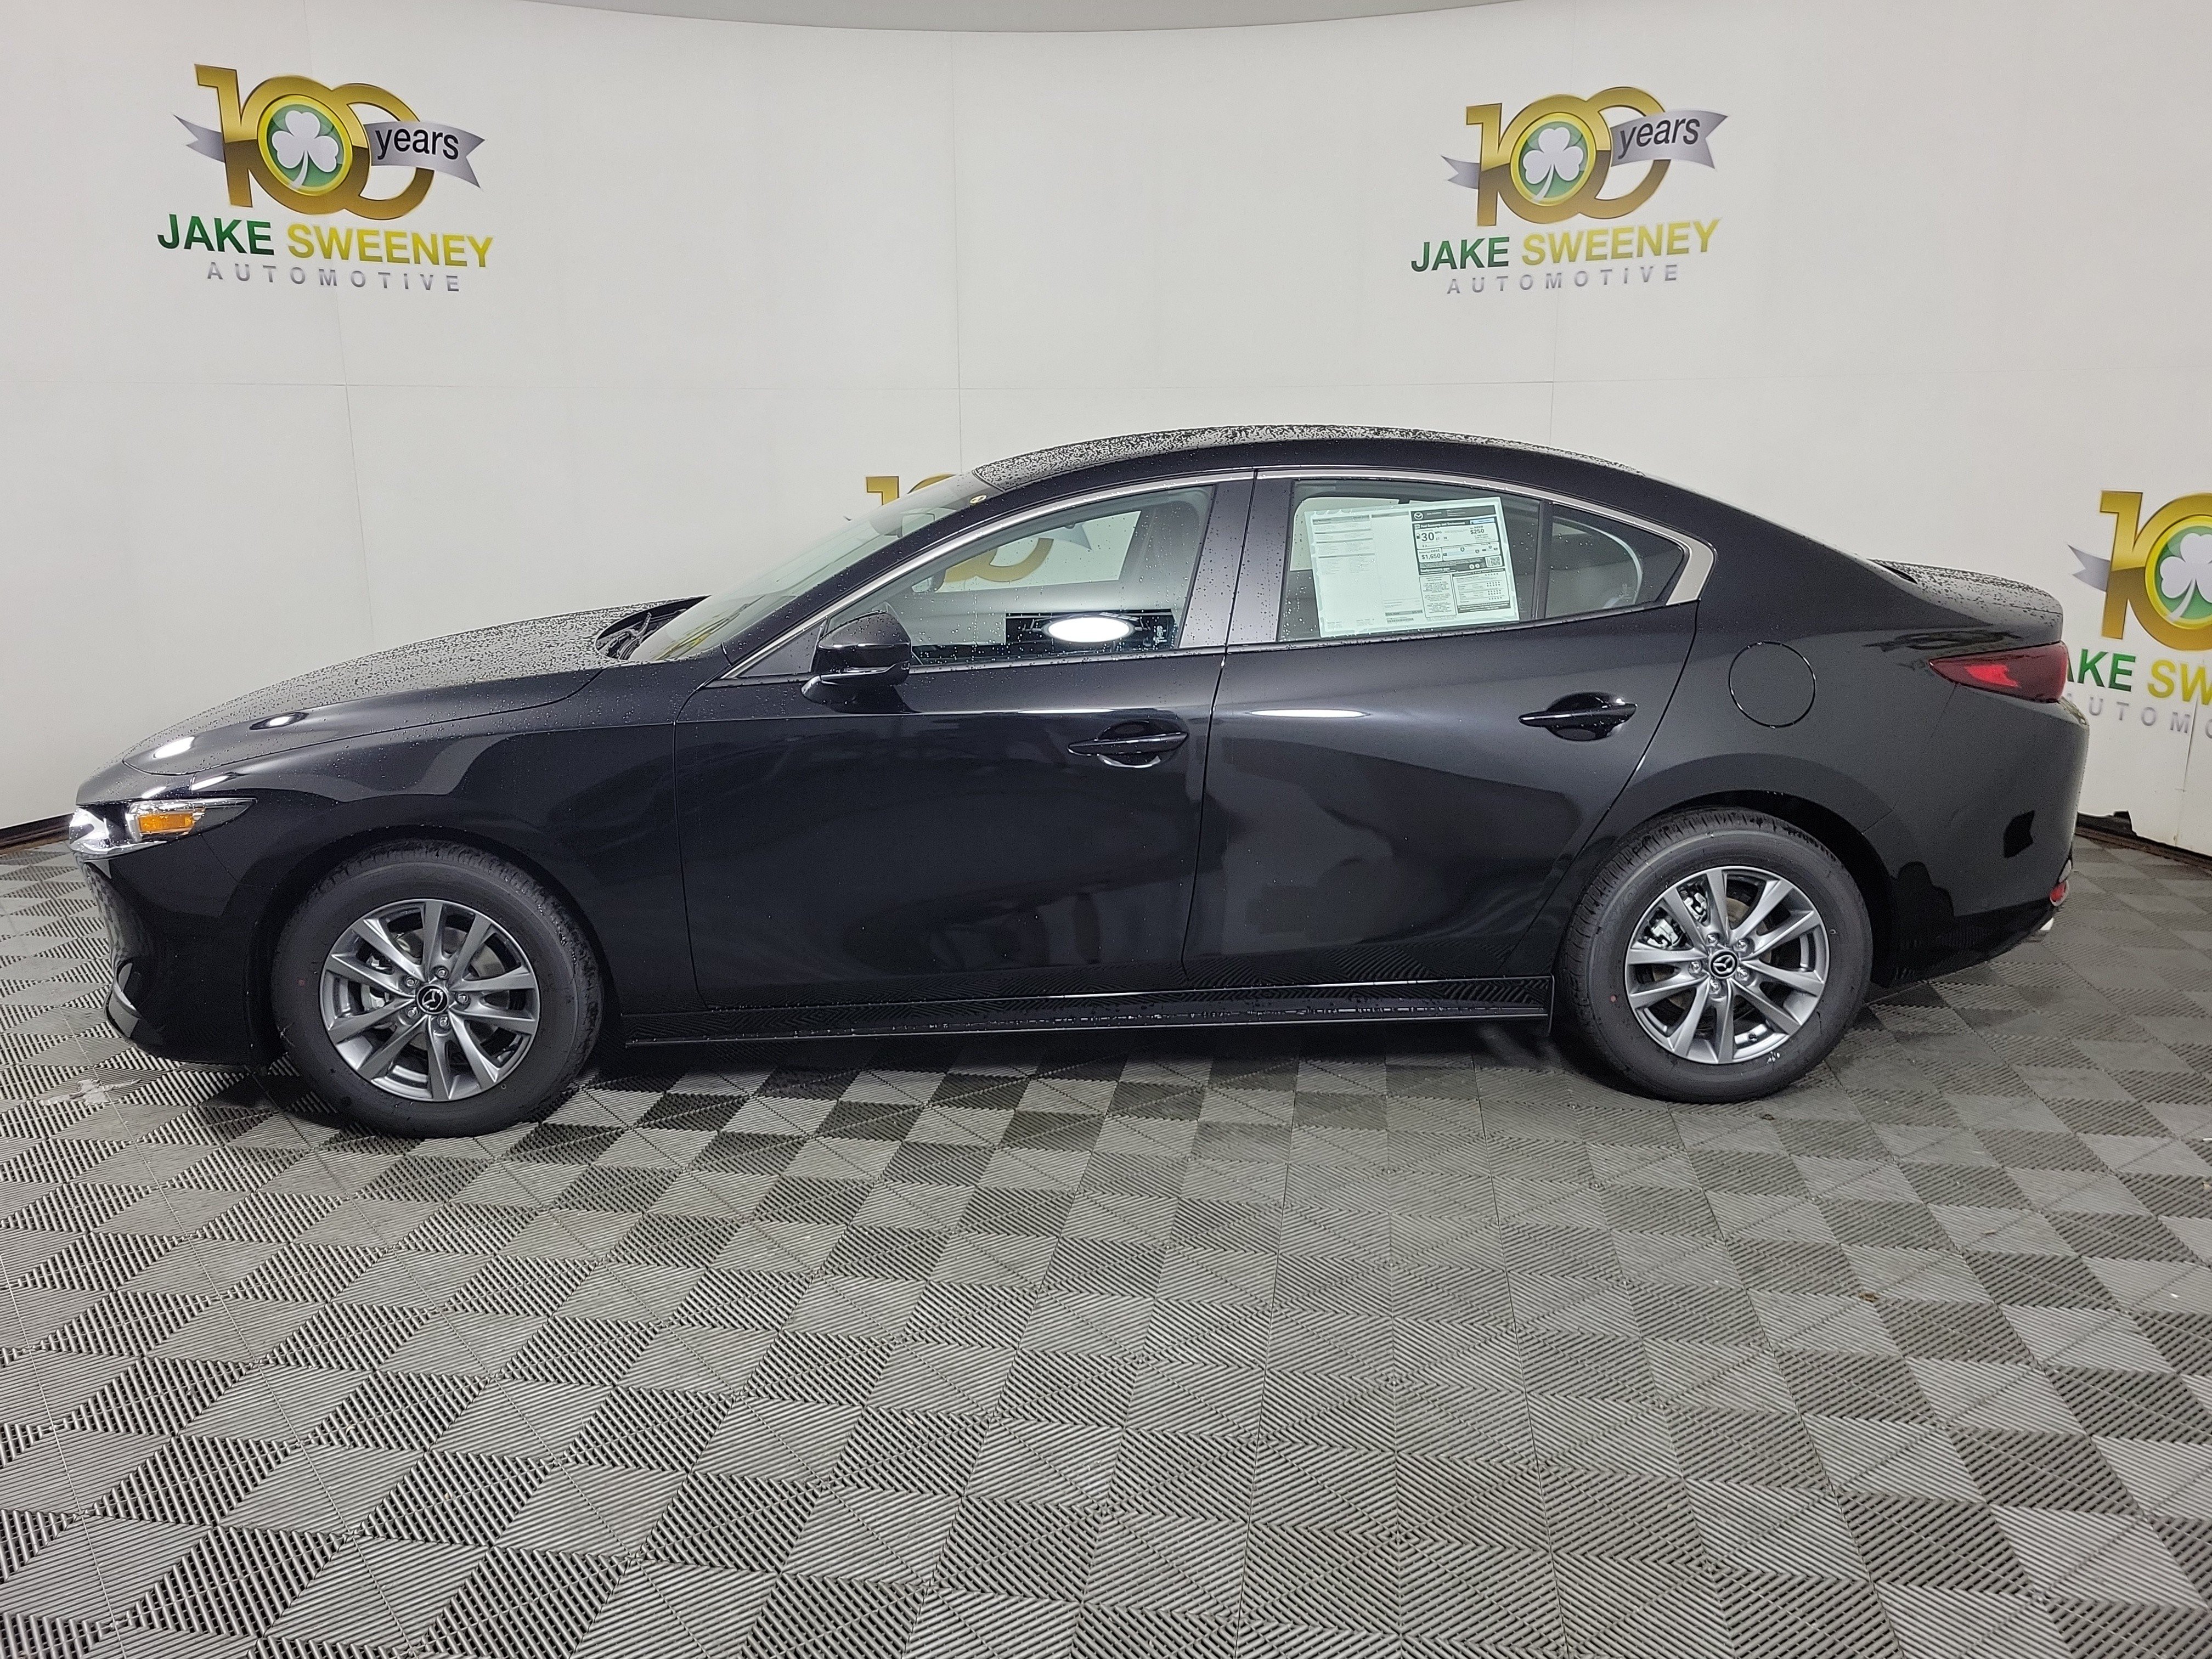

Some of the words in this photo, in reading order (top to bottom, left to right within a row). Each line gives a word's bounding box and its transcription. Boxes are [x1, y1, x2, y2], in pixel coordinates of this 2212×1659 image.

[194, 63, 435, 221] 100
[375, 127, 459, 161] years
[1465, 86, 1671, 227] 100
[1618, 116, 1701, 159] years
[157, 213, 275, 256] JAKE
[286, 223, 494, 268] SWEENEY
[1411, 236, 1510, 272] JAKE
[1521, 218, 1722, 267] SWEENEY
[207, 261, 460, 292] AUTOMOTIVE
[1447, 264, 1678, 295] AUTOMOTIVE
[1421, 532, 1435, 541] 30
[2100, 490, 2212, 651] 10
[2067, 648, 2136, 692] KE
[2147, 659, 2212, 706] SW
[2067, 692, 2212, 739] UTOM
